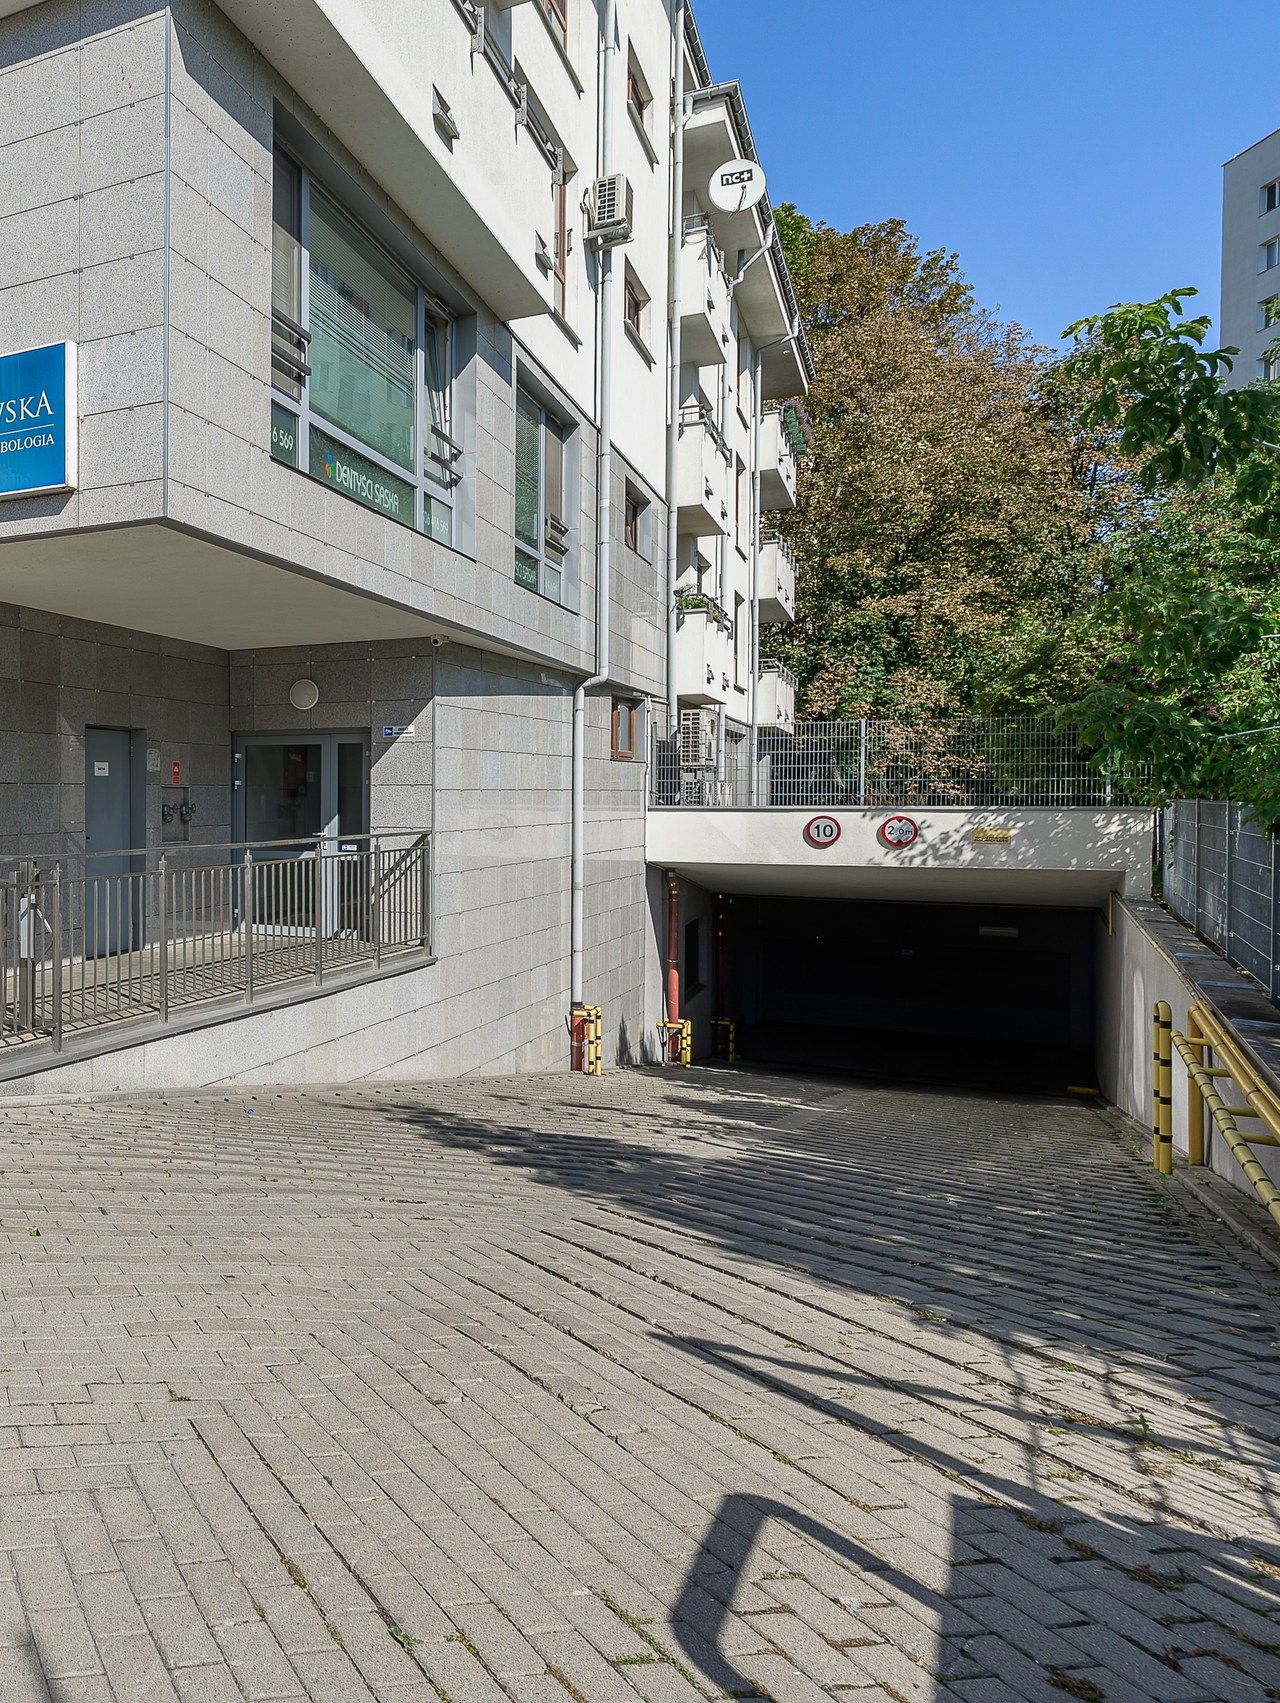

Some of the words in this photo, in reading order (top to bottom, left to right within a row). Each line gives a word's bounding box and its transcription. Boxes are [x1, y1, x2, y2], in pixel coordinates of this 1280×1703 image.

[722, 171, 751, 185] nc+
[279, 430, 294, 451] 569
[814, 824, 834, 838] 10
